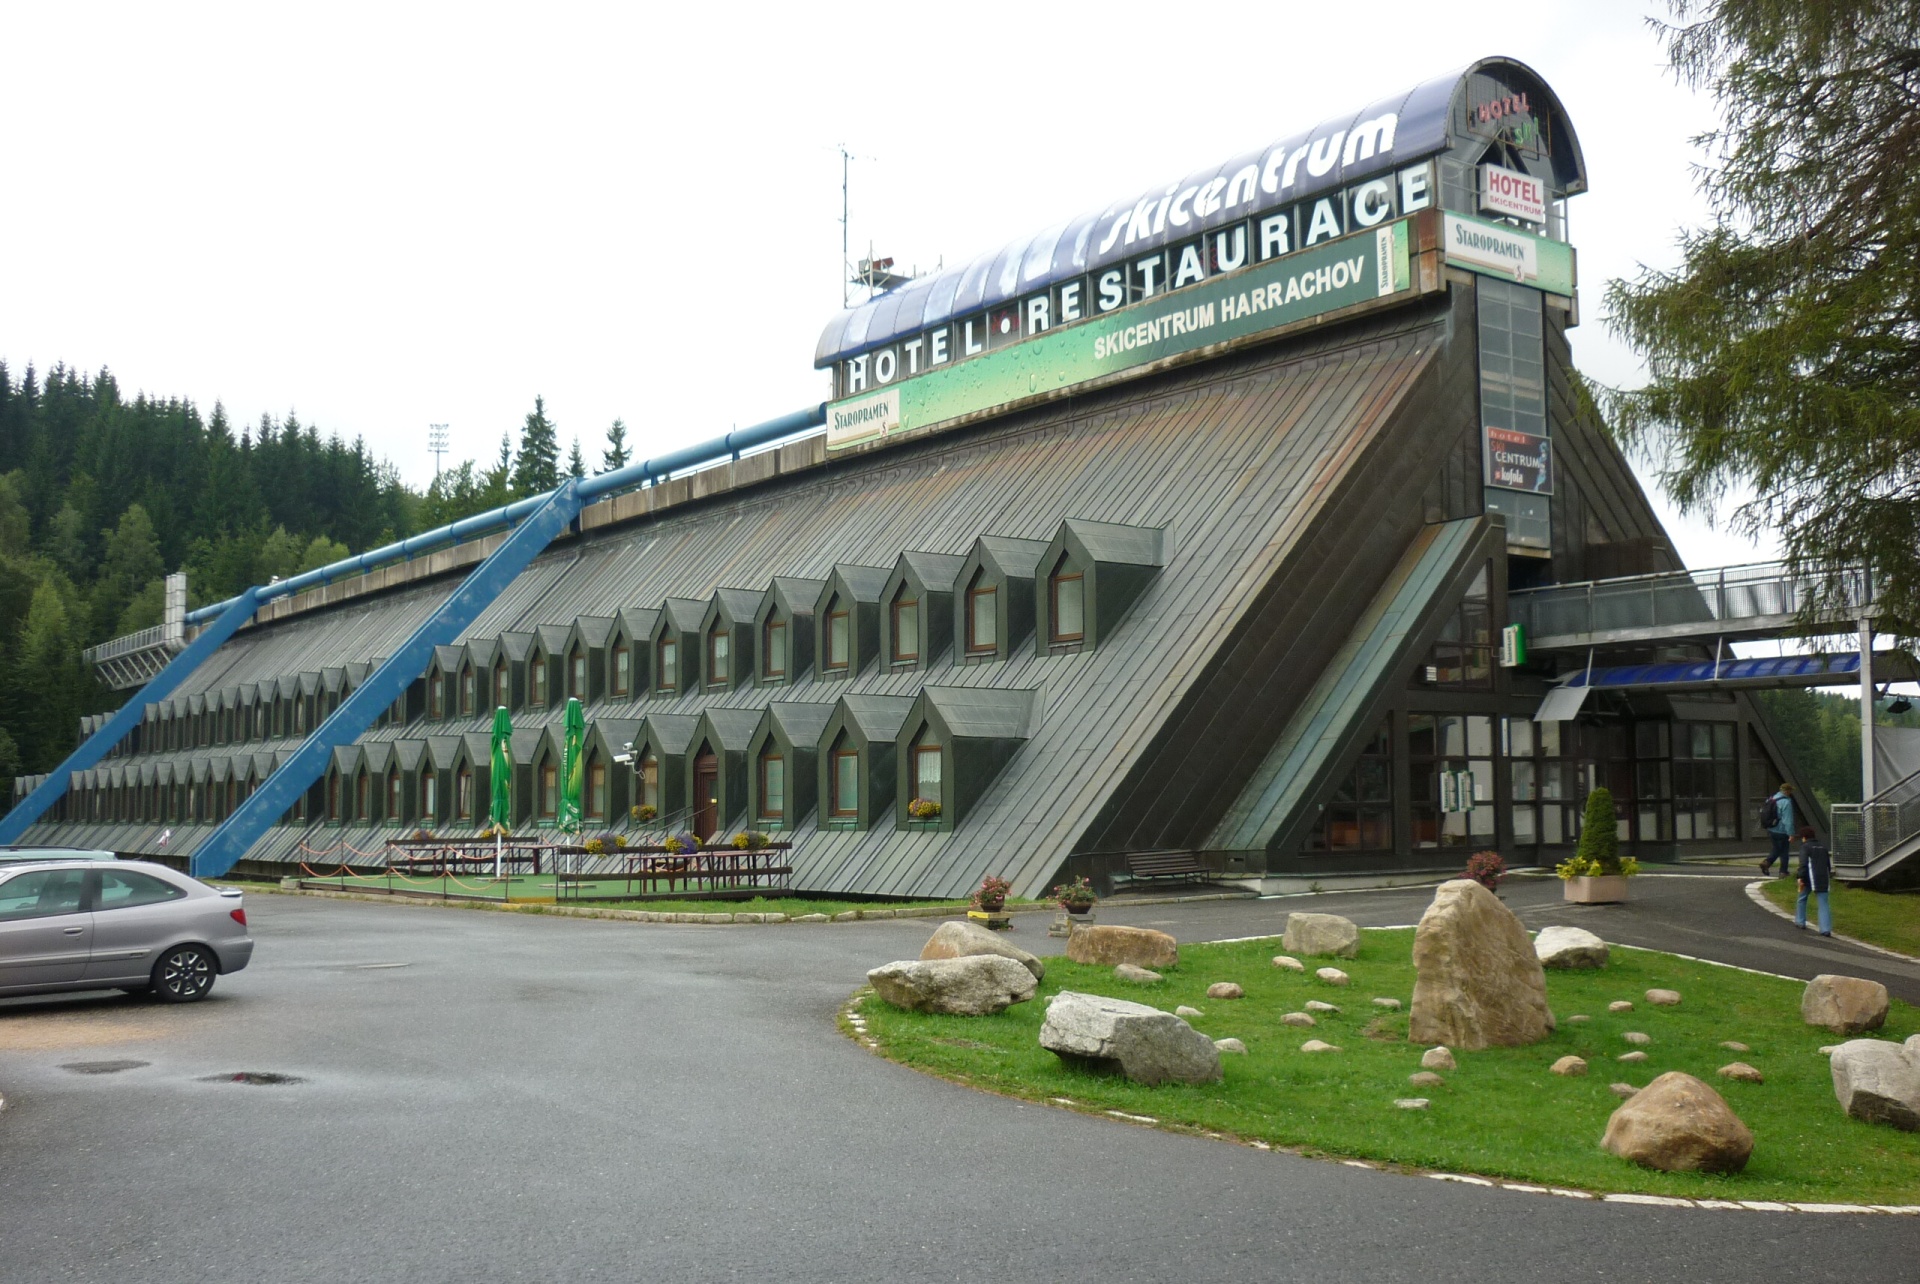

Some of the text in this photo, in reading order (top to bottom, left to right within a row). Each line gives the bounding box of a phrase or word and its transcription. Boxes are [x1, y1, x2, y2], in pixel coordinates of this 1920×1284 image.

[1478, 92, 1532, 124] HOTEL
[1489, 170, 1541, 205] HOTEL
[1489, 194, 1542, 217] SKICENTRUM
[847, 163, 1430, 394] HOTEL RESTAURACE
[1094, 255, 1365, 360] SKICENTRUM HARRACHOV
[1490, 430, 1526, 444] hotel
[1495, 451, 1541, 469] CENTRUM
[1501, 466, 1524, 486] kofola
